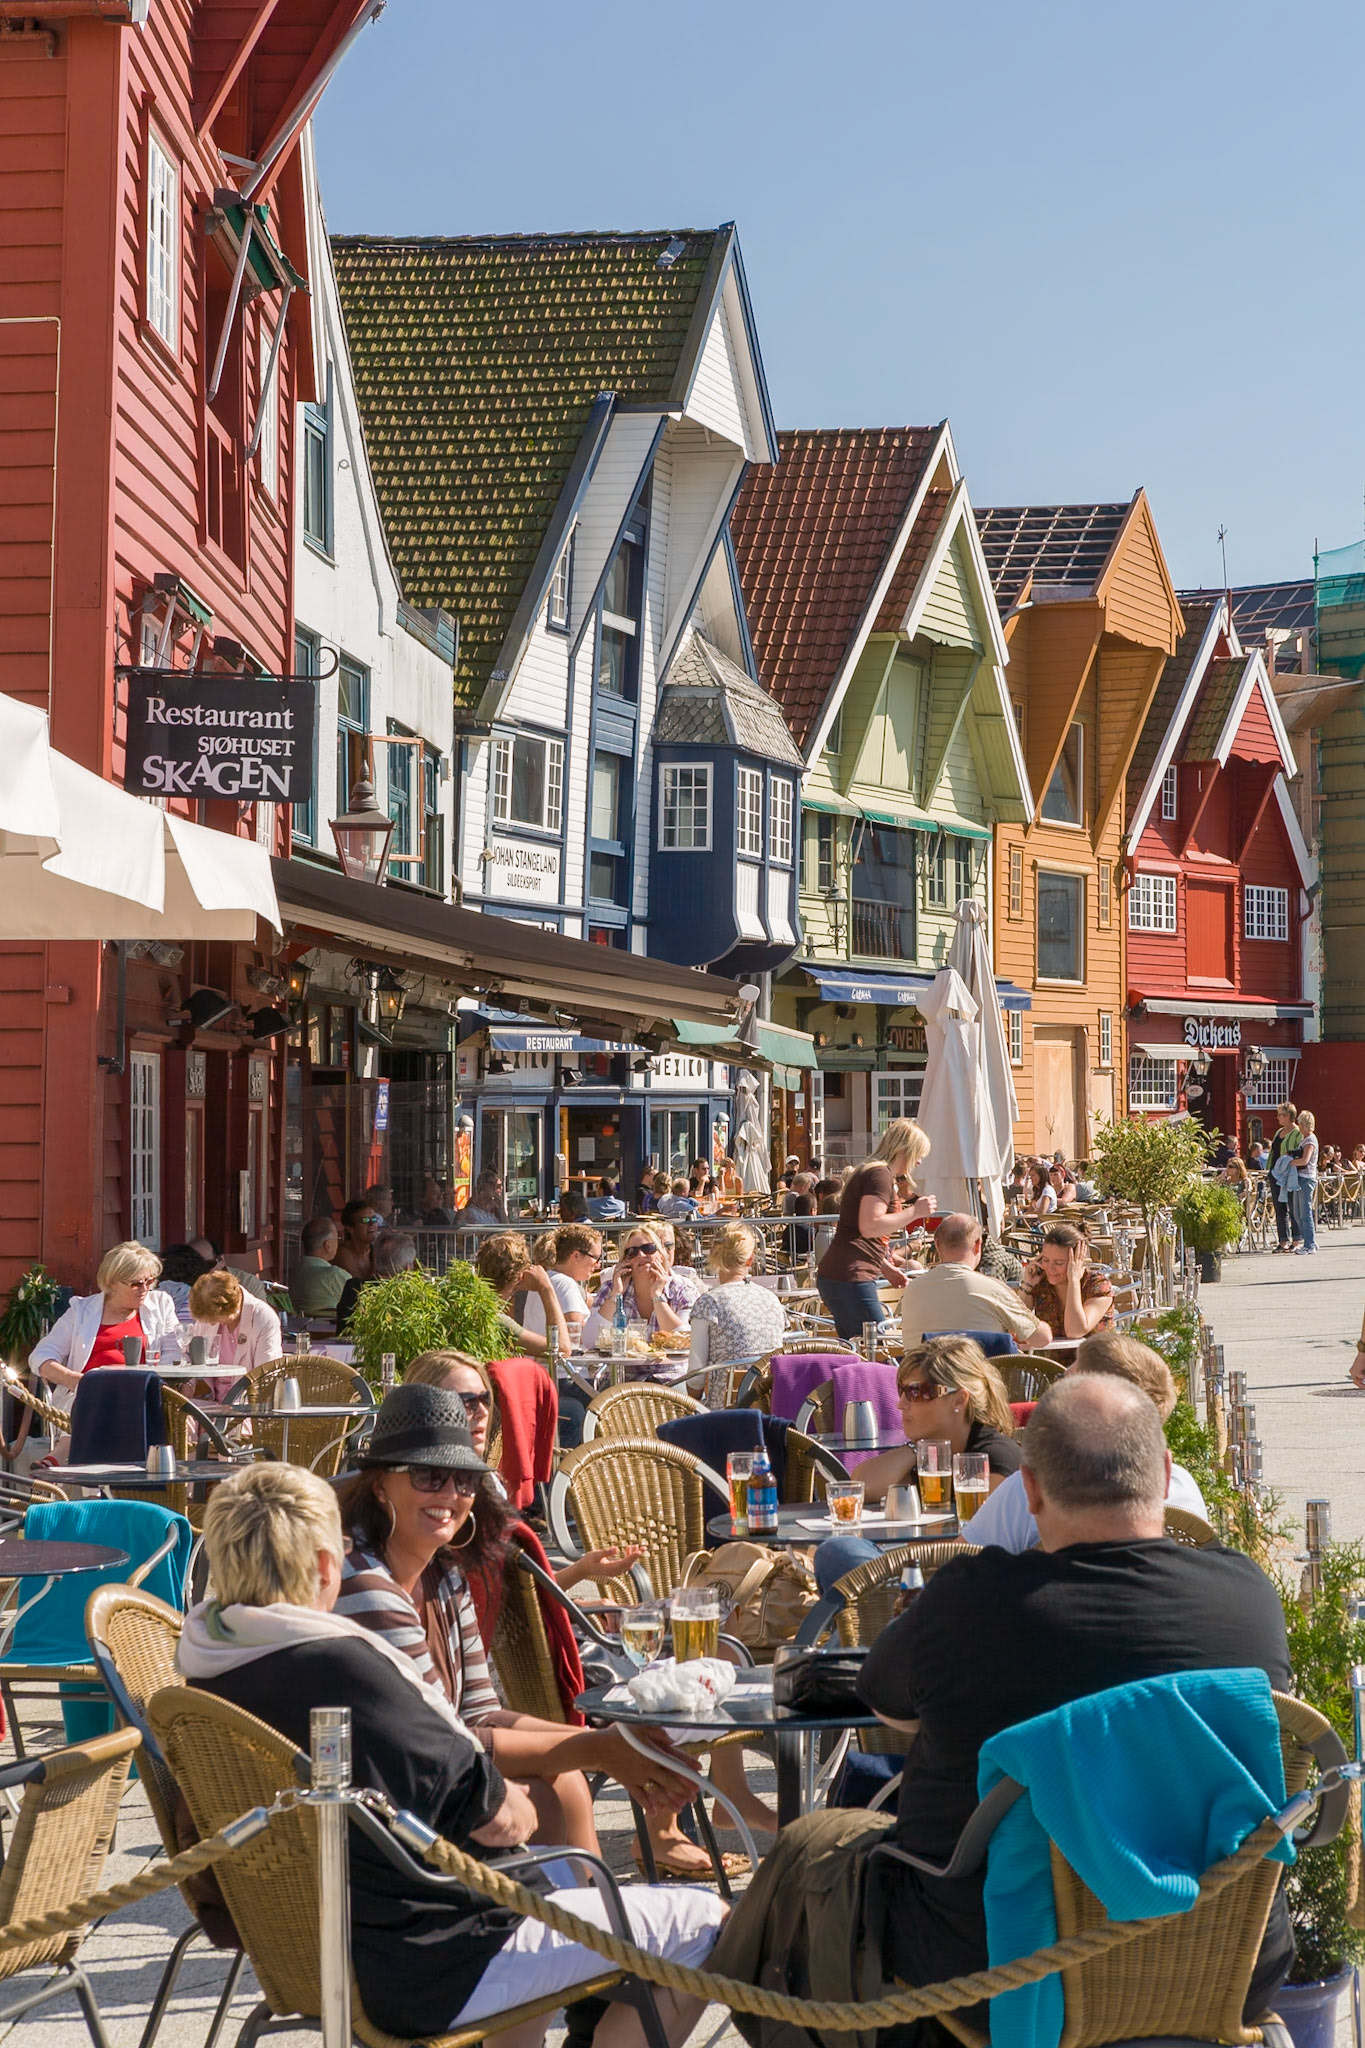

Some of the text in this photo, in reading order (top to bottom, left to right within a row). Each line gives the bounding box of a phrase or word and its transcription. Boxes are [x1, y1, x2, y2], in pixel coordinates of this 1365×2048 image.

[145, 697, 295, 730] Restaurant
[197, 736, 295, 756] SJØHUSET
[142, 754, 294, 798] SKAGEN
[492, 845, 557, 875] JOHAN STANGELAND
[506, 873, 541, 892] SILDEEKSPORT
[526, 1037, 574, 1050] RESTAURANT
[1184, 1017, 1242, 1052] Dickens
[654, 1057, 703, 1077] MEXIKO
